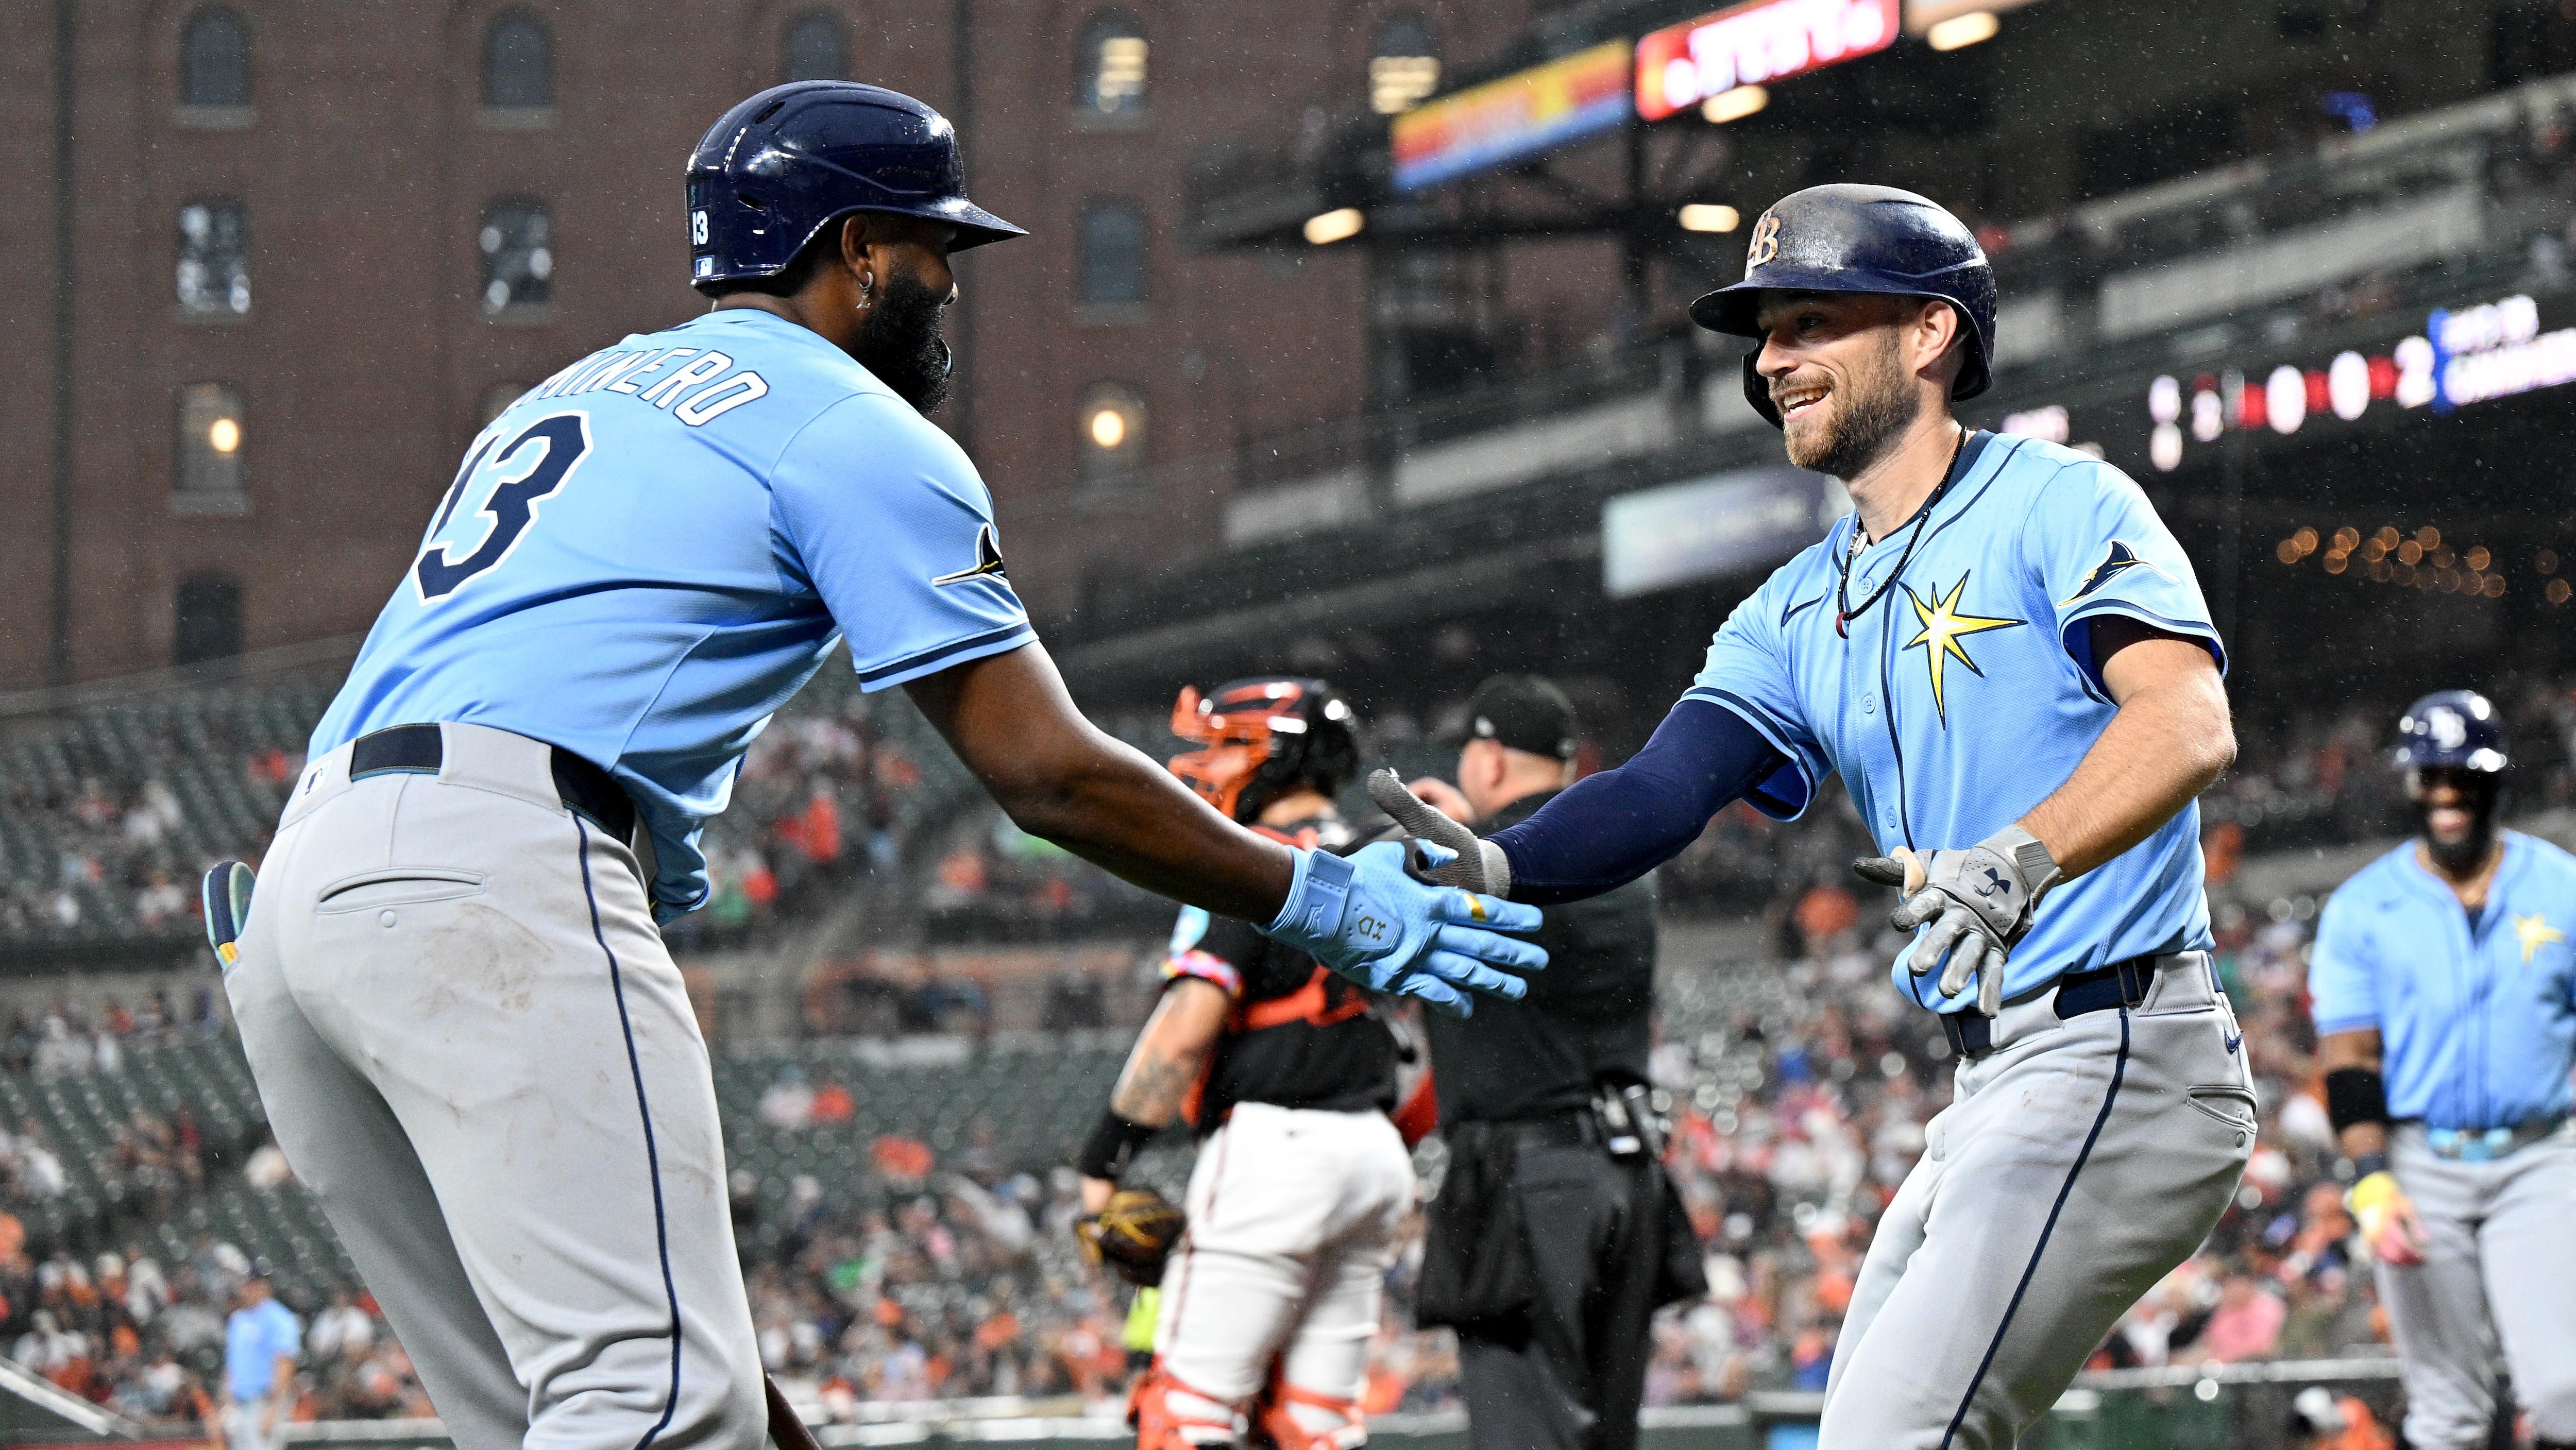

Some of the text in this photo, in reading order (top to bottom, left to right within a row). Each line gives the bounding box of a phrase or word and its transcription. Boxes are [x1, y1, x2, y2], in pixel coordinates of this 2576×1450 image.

[692, 211, 708, 245] 13
[497, 347, 770, 427] MINERO
[413, 410, 594, 606] 13
